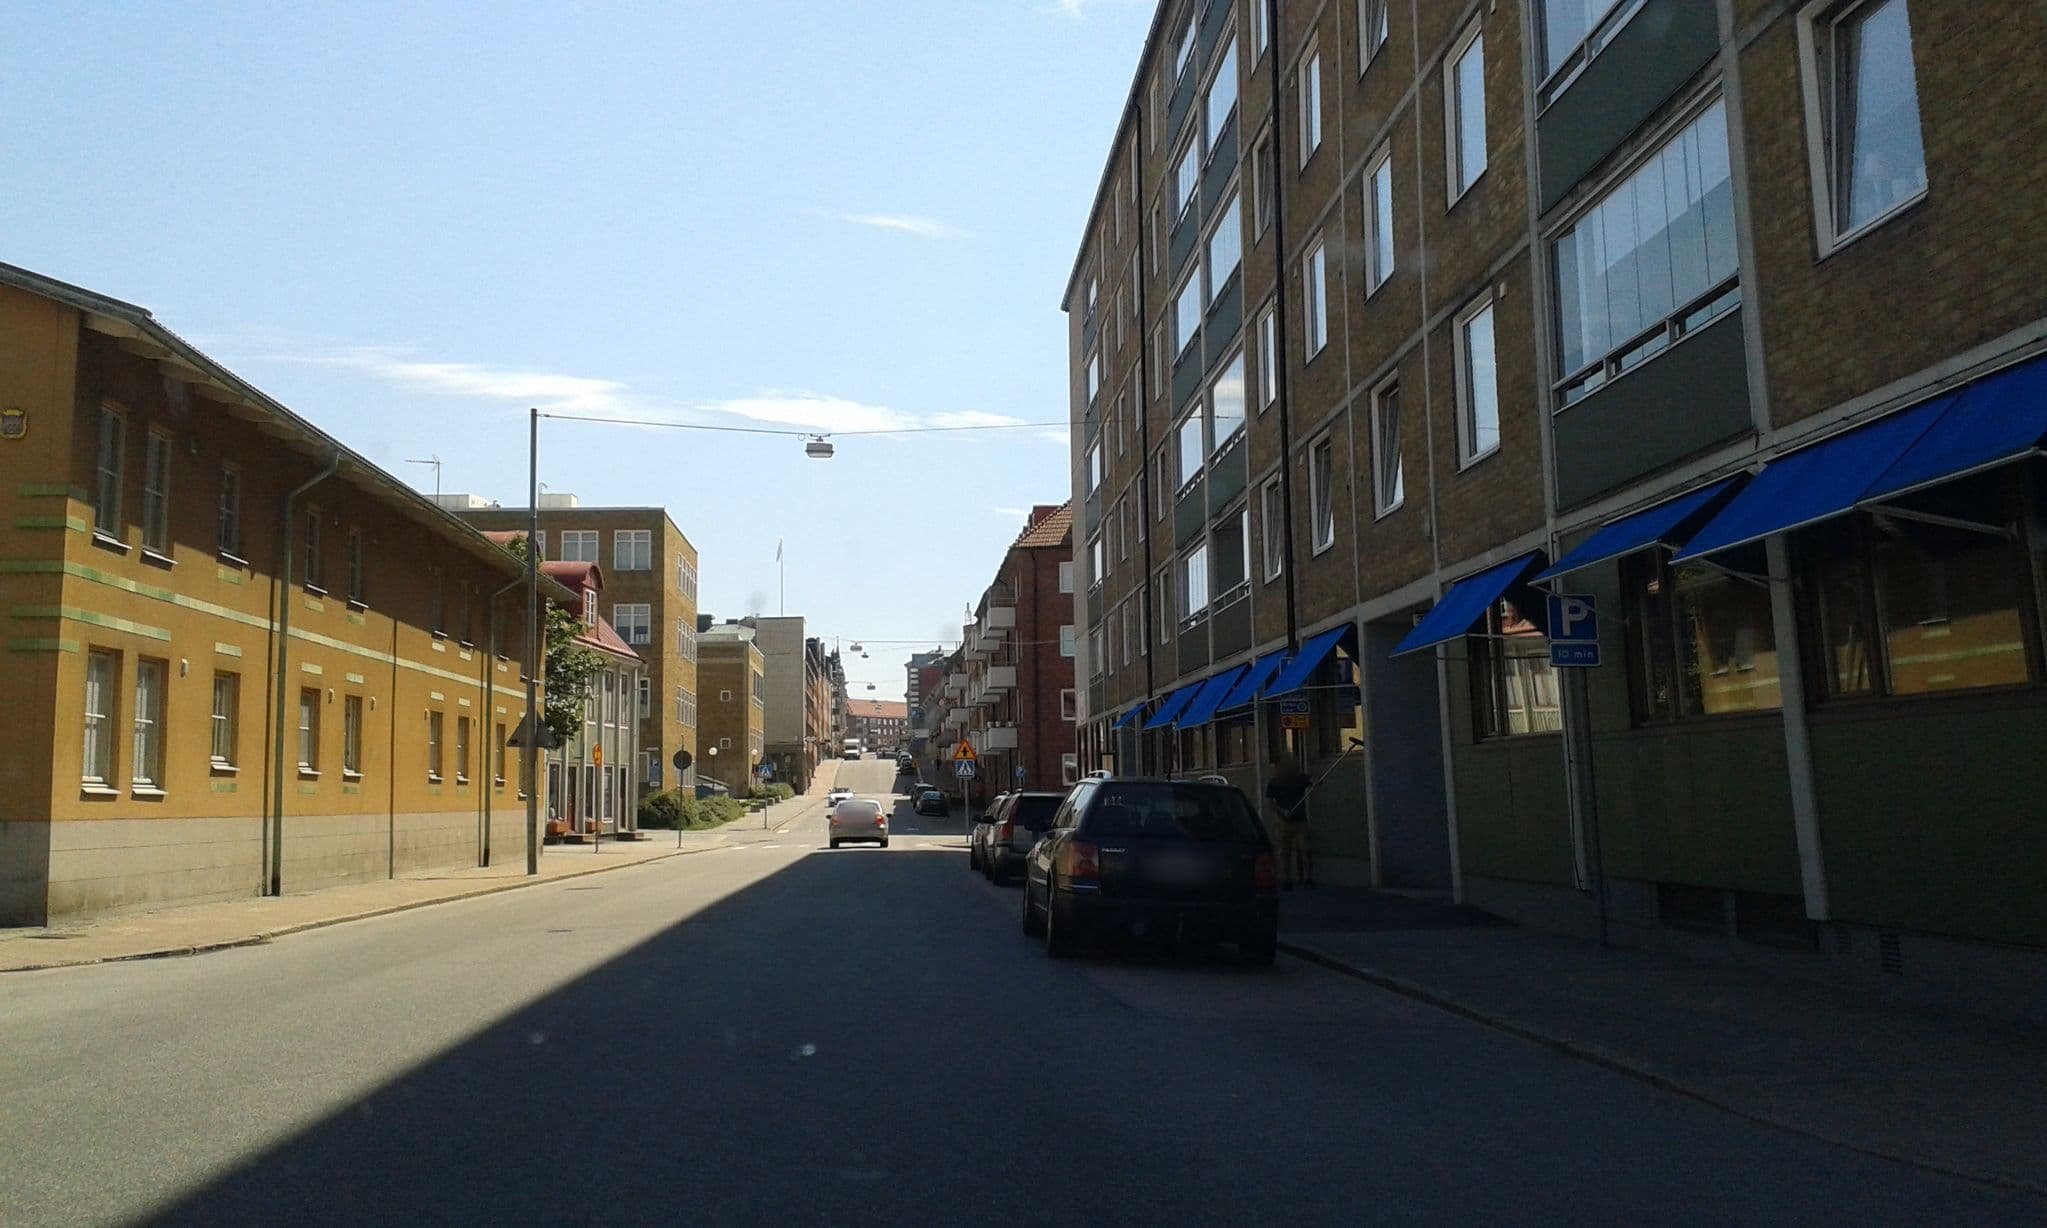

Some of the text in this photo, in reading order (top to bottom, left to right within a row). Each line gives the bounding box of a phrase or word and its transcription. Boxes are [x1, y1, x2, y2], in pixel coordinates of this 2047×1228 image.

[1561, 597, 1588, 636] P
[1558, 649, 1594, 658] 10 min
